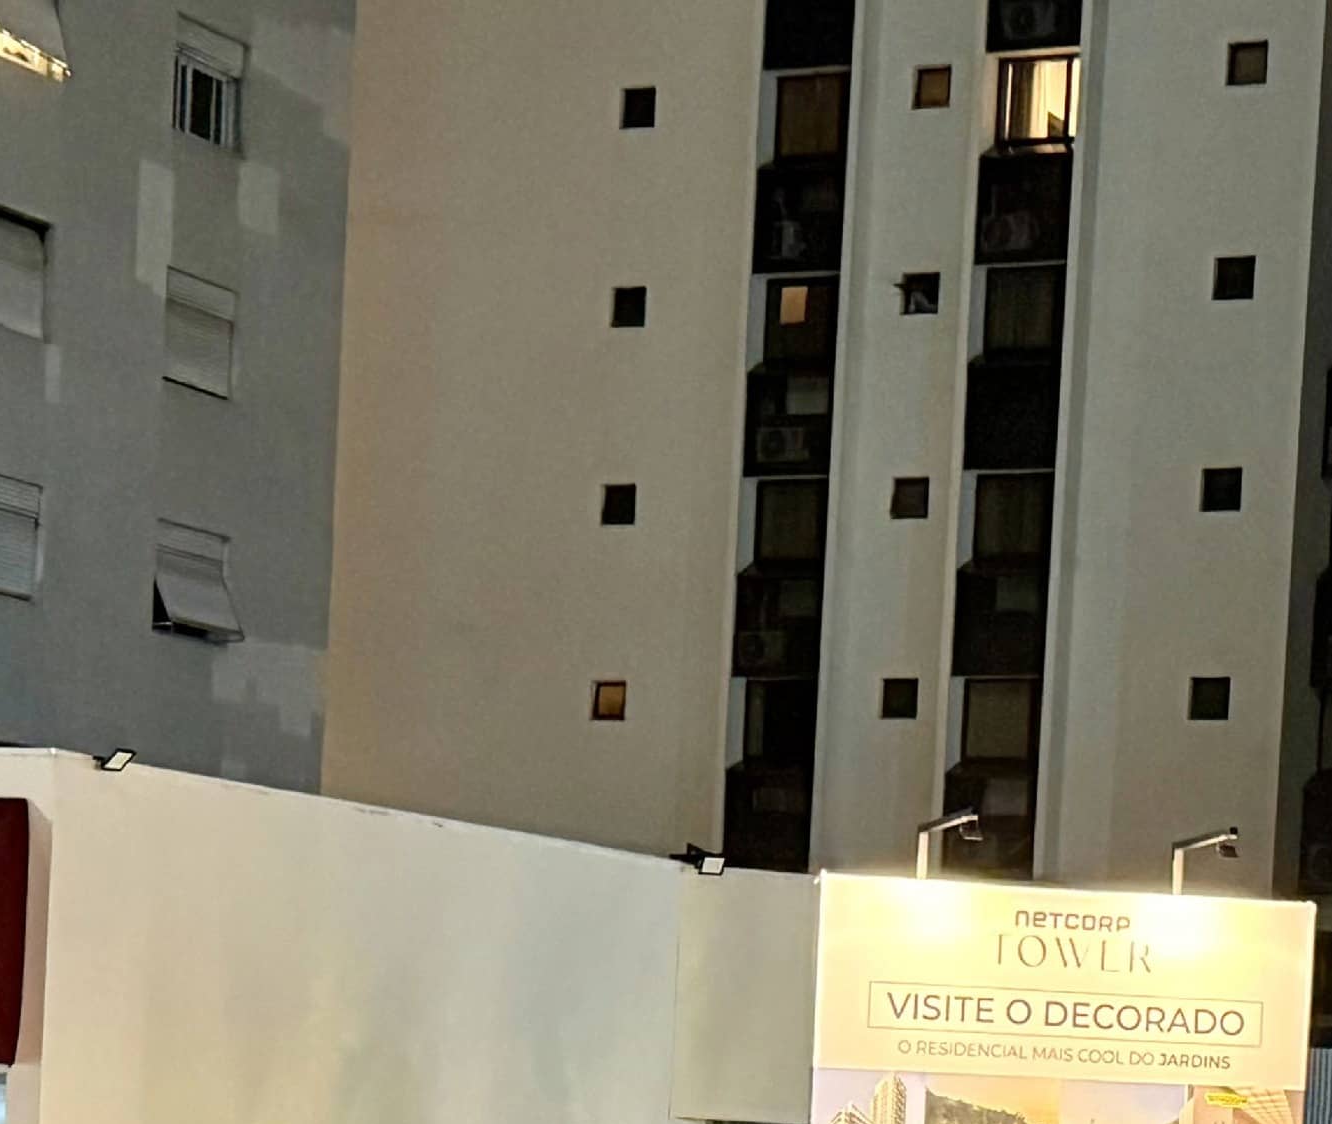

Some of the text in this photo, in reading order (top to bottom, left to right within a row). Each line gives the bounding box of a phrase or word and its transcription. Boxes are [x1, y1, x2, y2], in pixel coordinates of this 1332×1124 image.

[886, 991, 1245, 1037] VISITE O DECORADO
[897, 1039, 1231, 1070] O RESIDENCIAL MAIS COOL DO JARDINS
